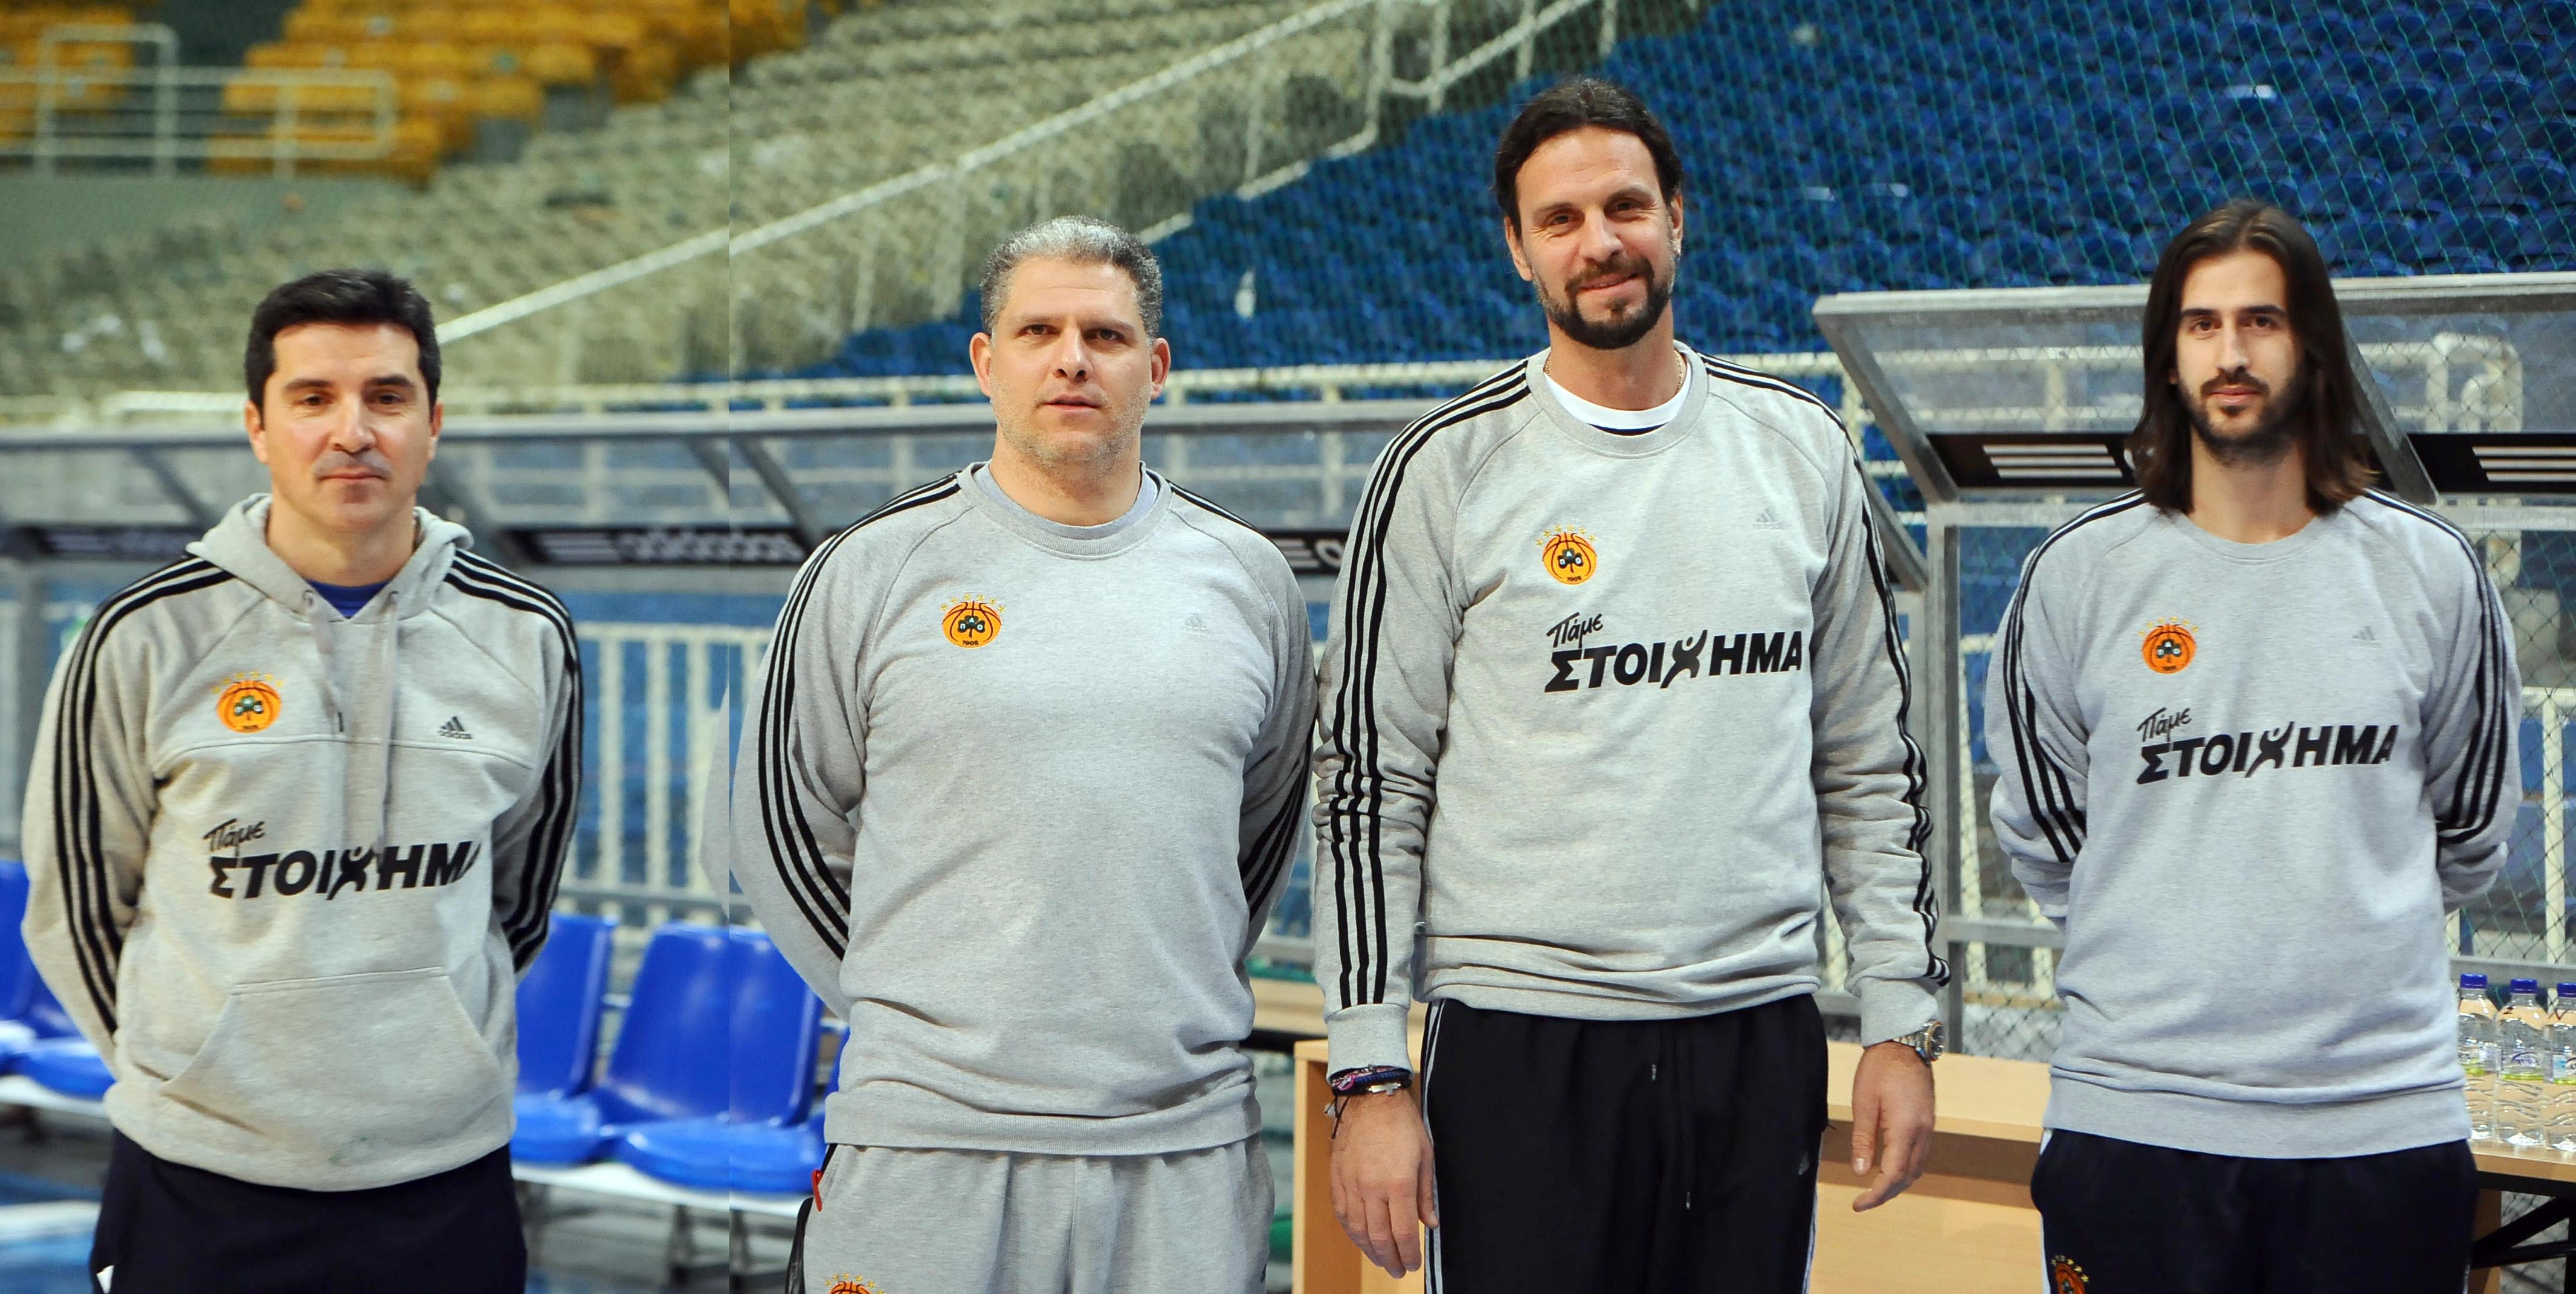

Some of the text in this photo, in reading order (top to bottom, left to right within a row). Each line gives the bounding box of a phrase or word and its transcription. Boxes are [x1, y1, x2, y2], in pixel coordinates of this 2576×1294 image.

[1546, 612, 1604, 649] Πάμε
[1544, 630, 1802, 693] ΣΤΟΙΧΗΜΑ
[2136, 707, 2192, 743] Πάμε
[2137, 721, 2399, 785] ΣΤΟΙΧΗΜΑ
